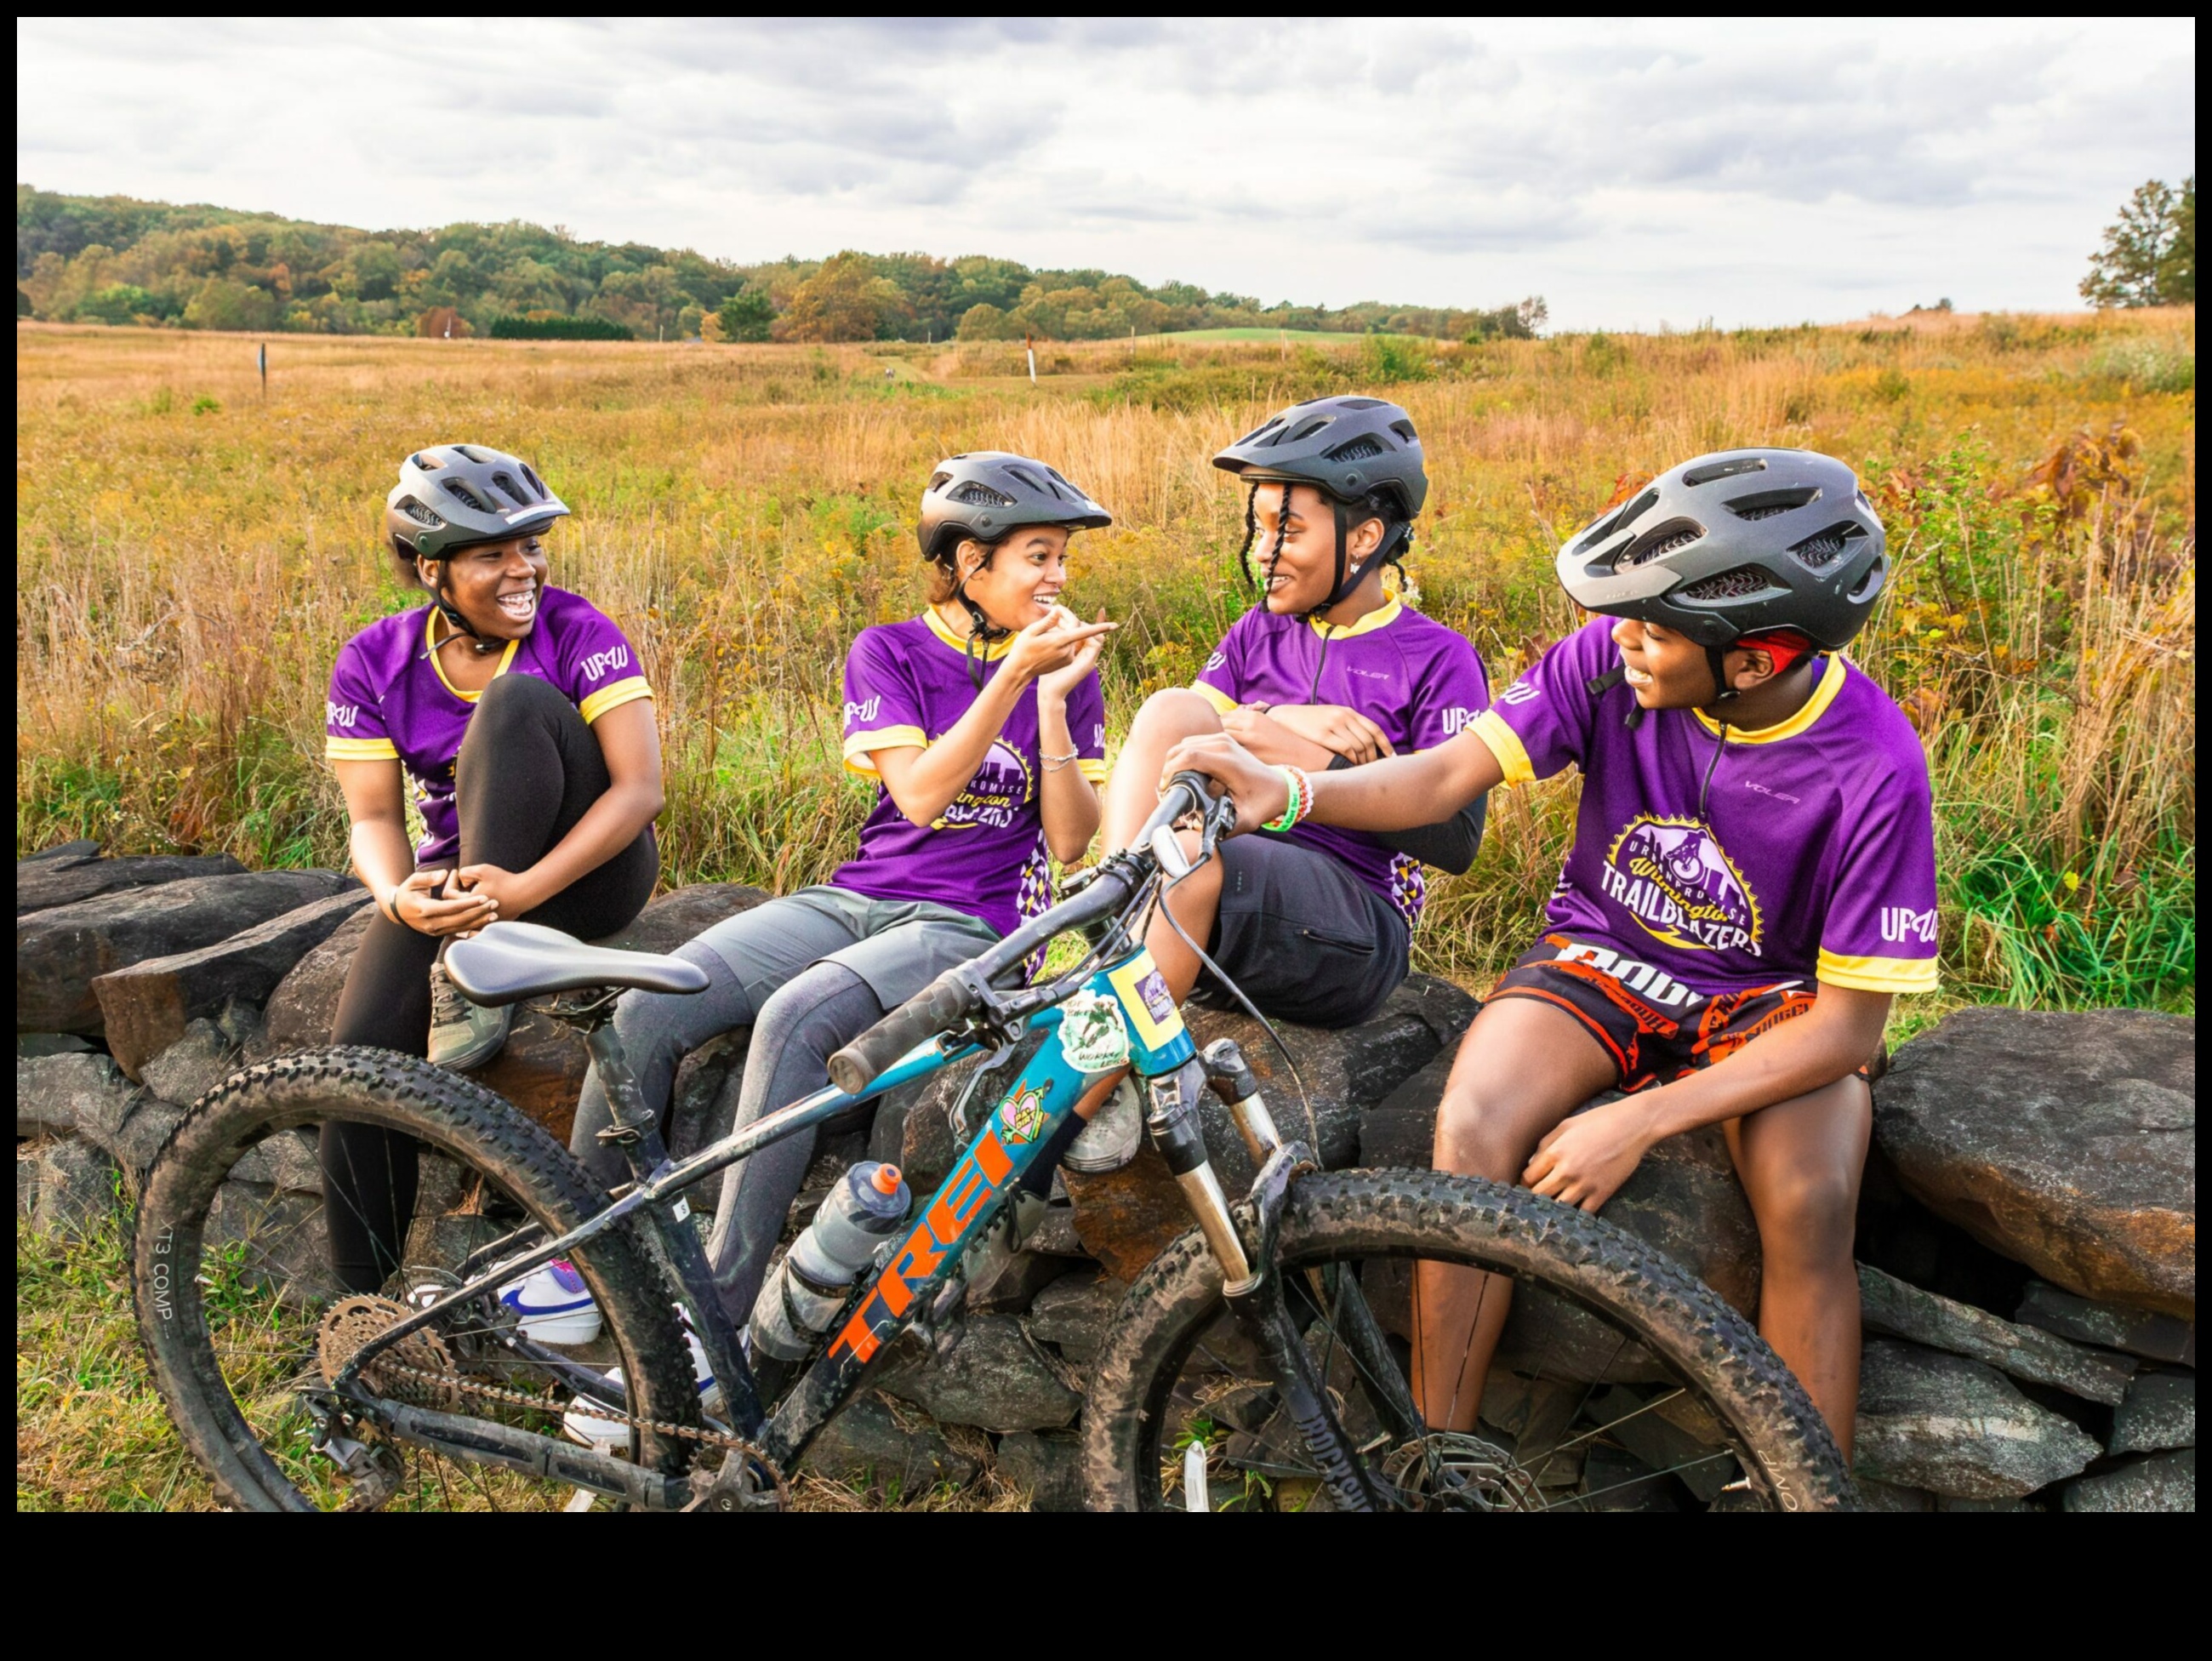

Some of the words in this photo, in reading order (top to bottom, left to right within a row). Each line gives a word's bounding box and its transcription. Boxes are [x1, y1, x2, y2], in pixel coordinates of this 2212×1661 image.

[1442, 707, 1480, 734] UP
[153, 1264, 173, 1320] COMP
[1758, 1450, 1798, 1512] OMP
